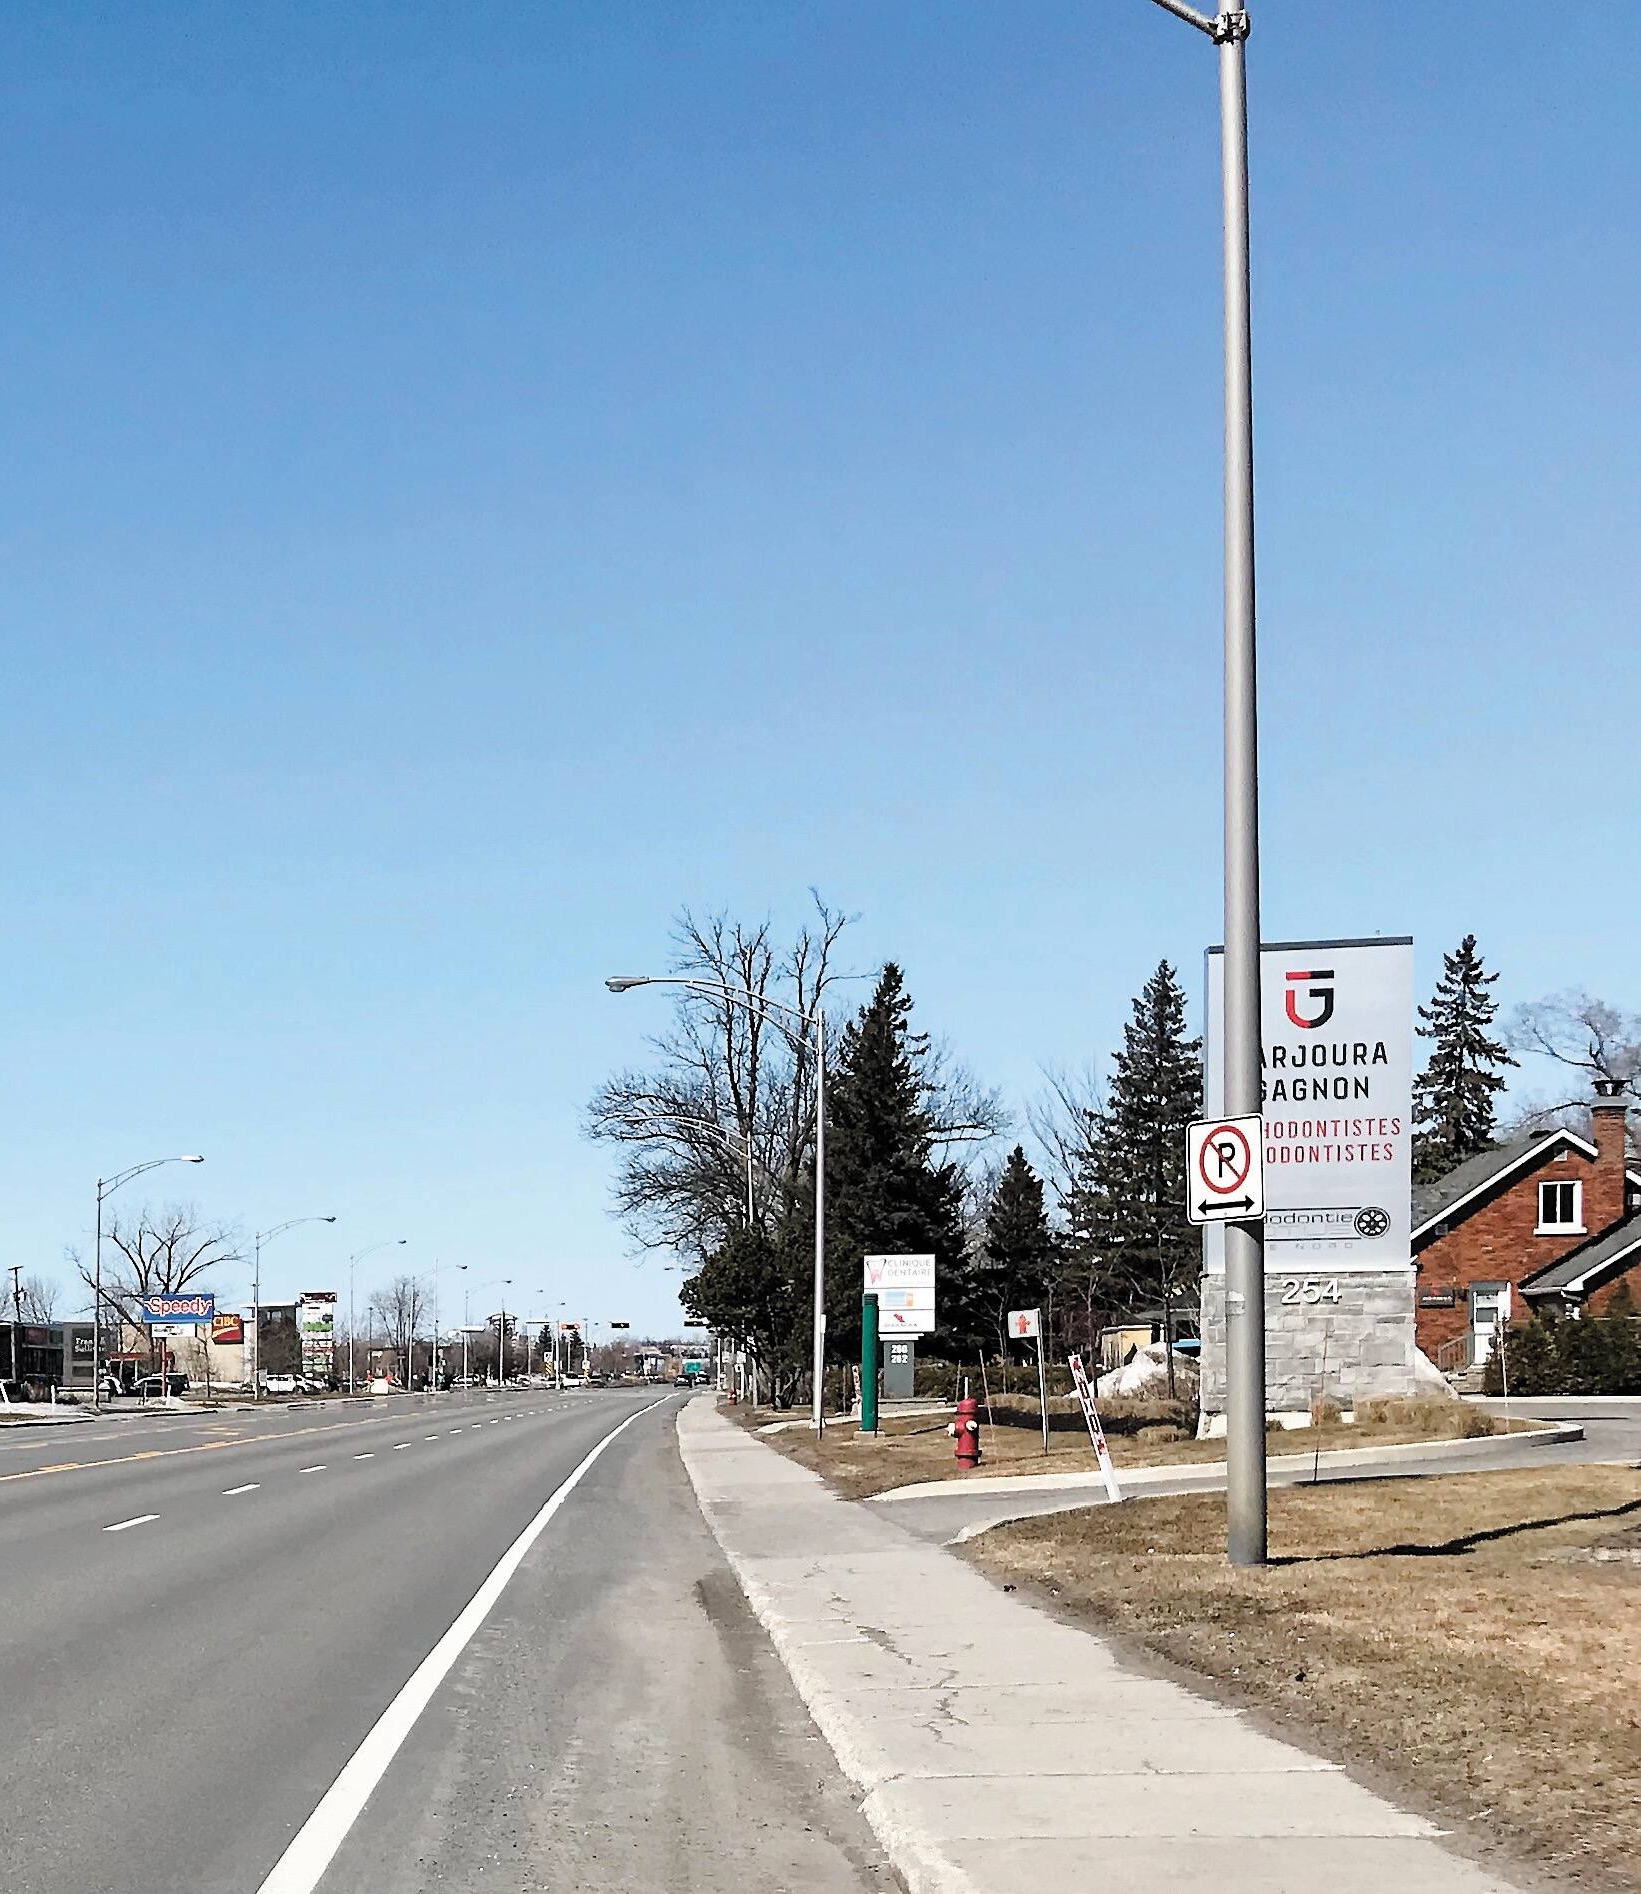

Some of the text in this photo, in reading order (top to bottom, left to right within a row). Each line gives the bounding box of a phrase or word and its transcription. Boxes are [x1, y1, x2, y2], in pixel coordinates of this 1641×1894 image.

[1266, 1142, 1393, 1164] ODONTISTES
[887, 1258, 931, 1268] CLINIQUE
[887, 1268, 932, 1277] DENTAIRE
[1281, 1278, 1342, 1304] 254
[144, 1297, 212, 1316] Speedy
